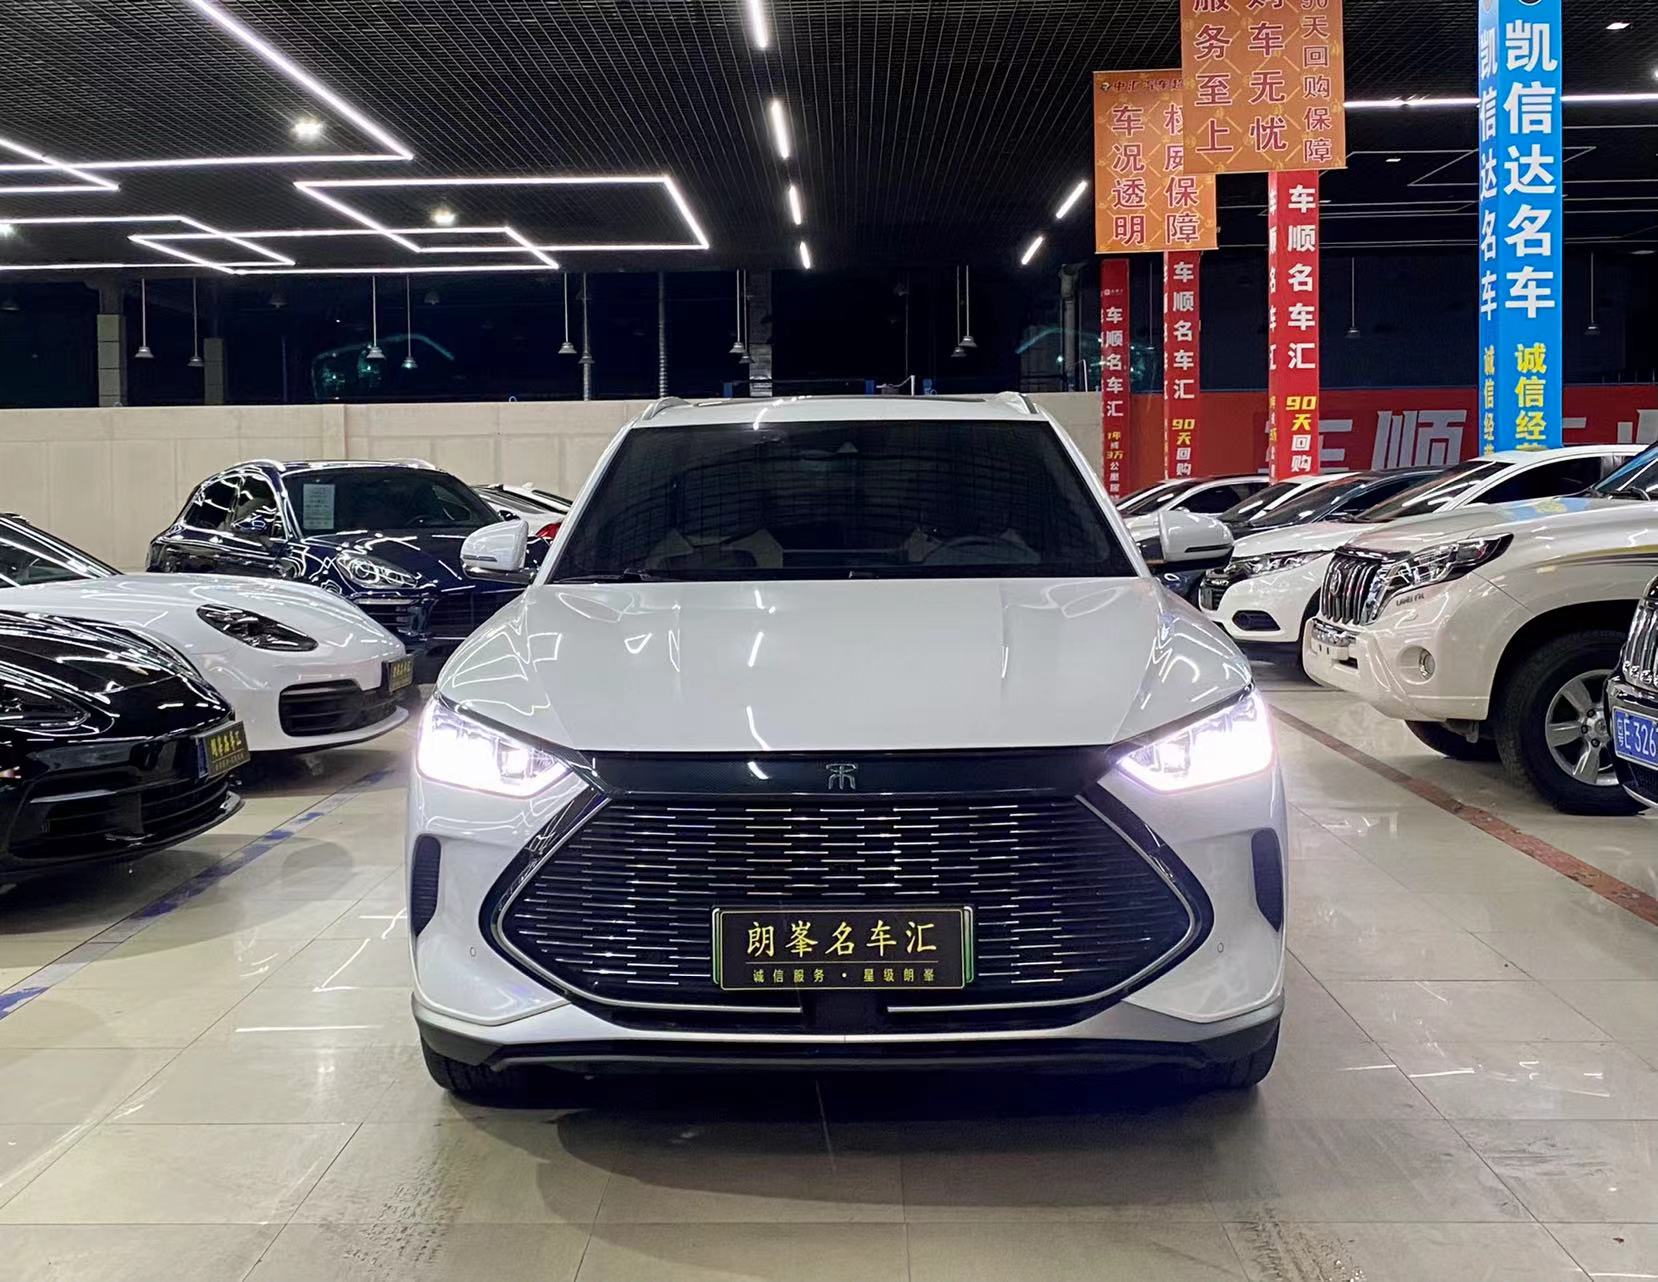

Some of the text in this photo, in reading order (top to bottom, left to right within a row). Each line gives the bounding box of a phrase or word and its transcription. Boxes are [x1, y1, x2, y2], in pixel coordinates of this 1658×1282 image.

[1248, 0, 1288, 152] 车无忧
[1112, 104, 1147, 247] 车况透明
[1480, 28, 1498, 321] 凯信达名车
[1503, 19, 1558, 318] 凯信达名车
[1173, 261, 1195, 400] 车顺名车汇
[1287, 184, 1317, 370] 车顺名车汇
[1105, 306, 1124, 417] 车顺名车汇
[1171, 418, 1195, 476] 90天回购
[1285, 396, 1317, 473] 90天回购
